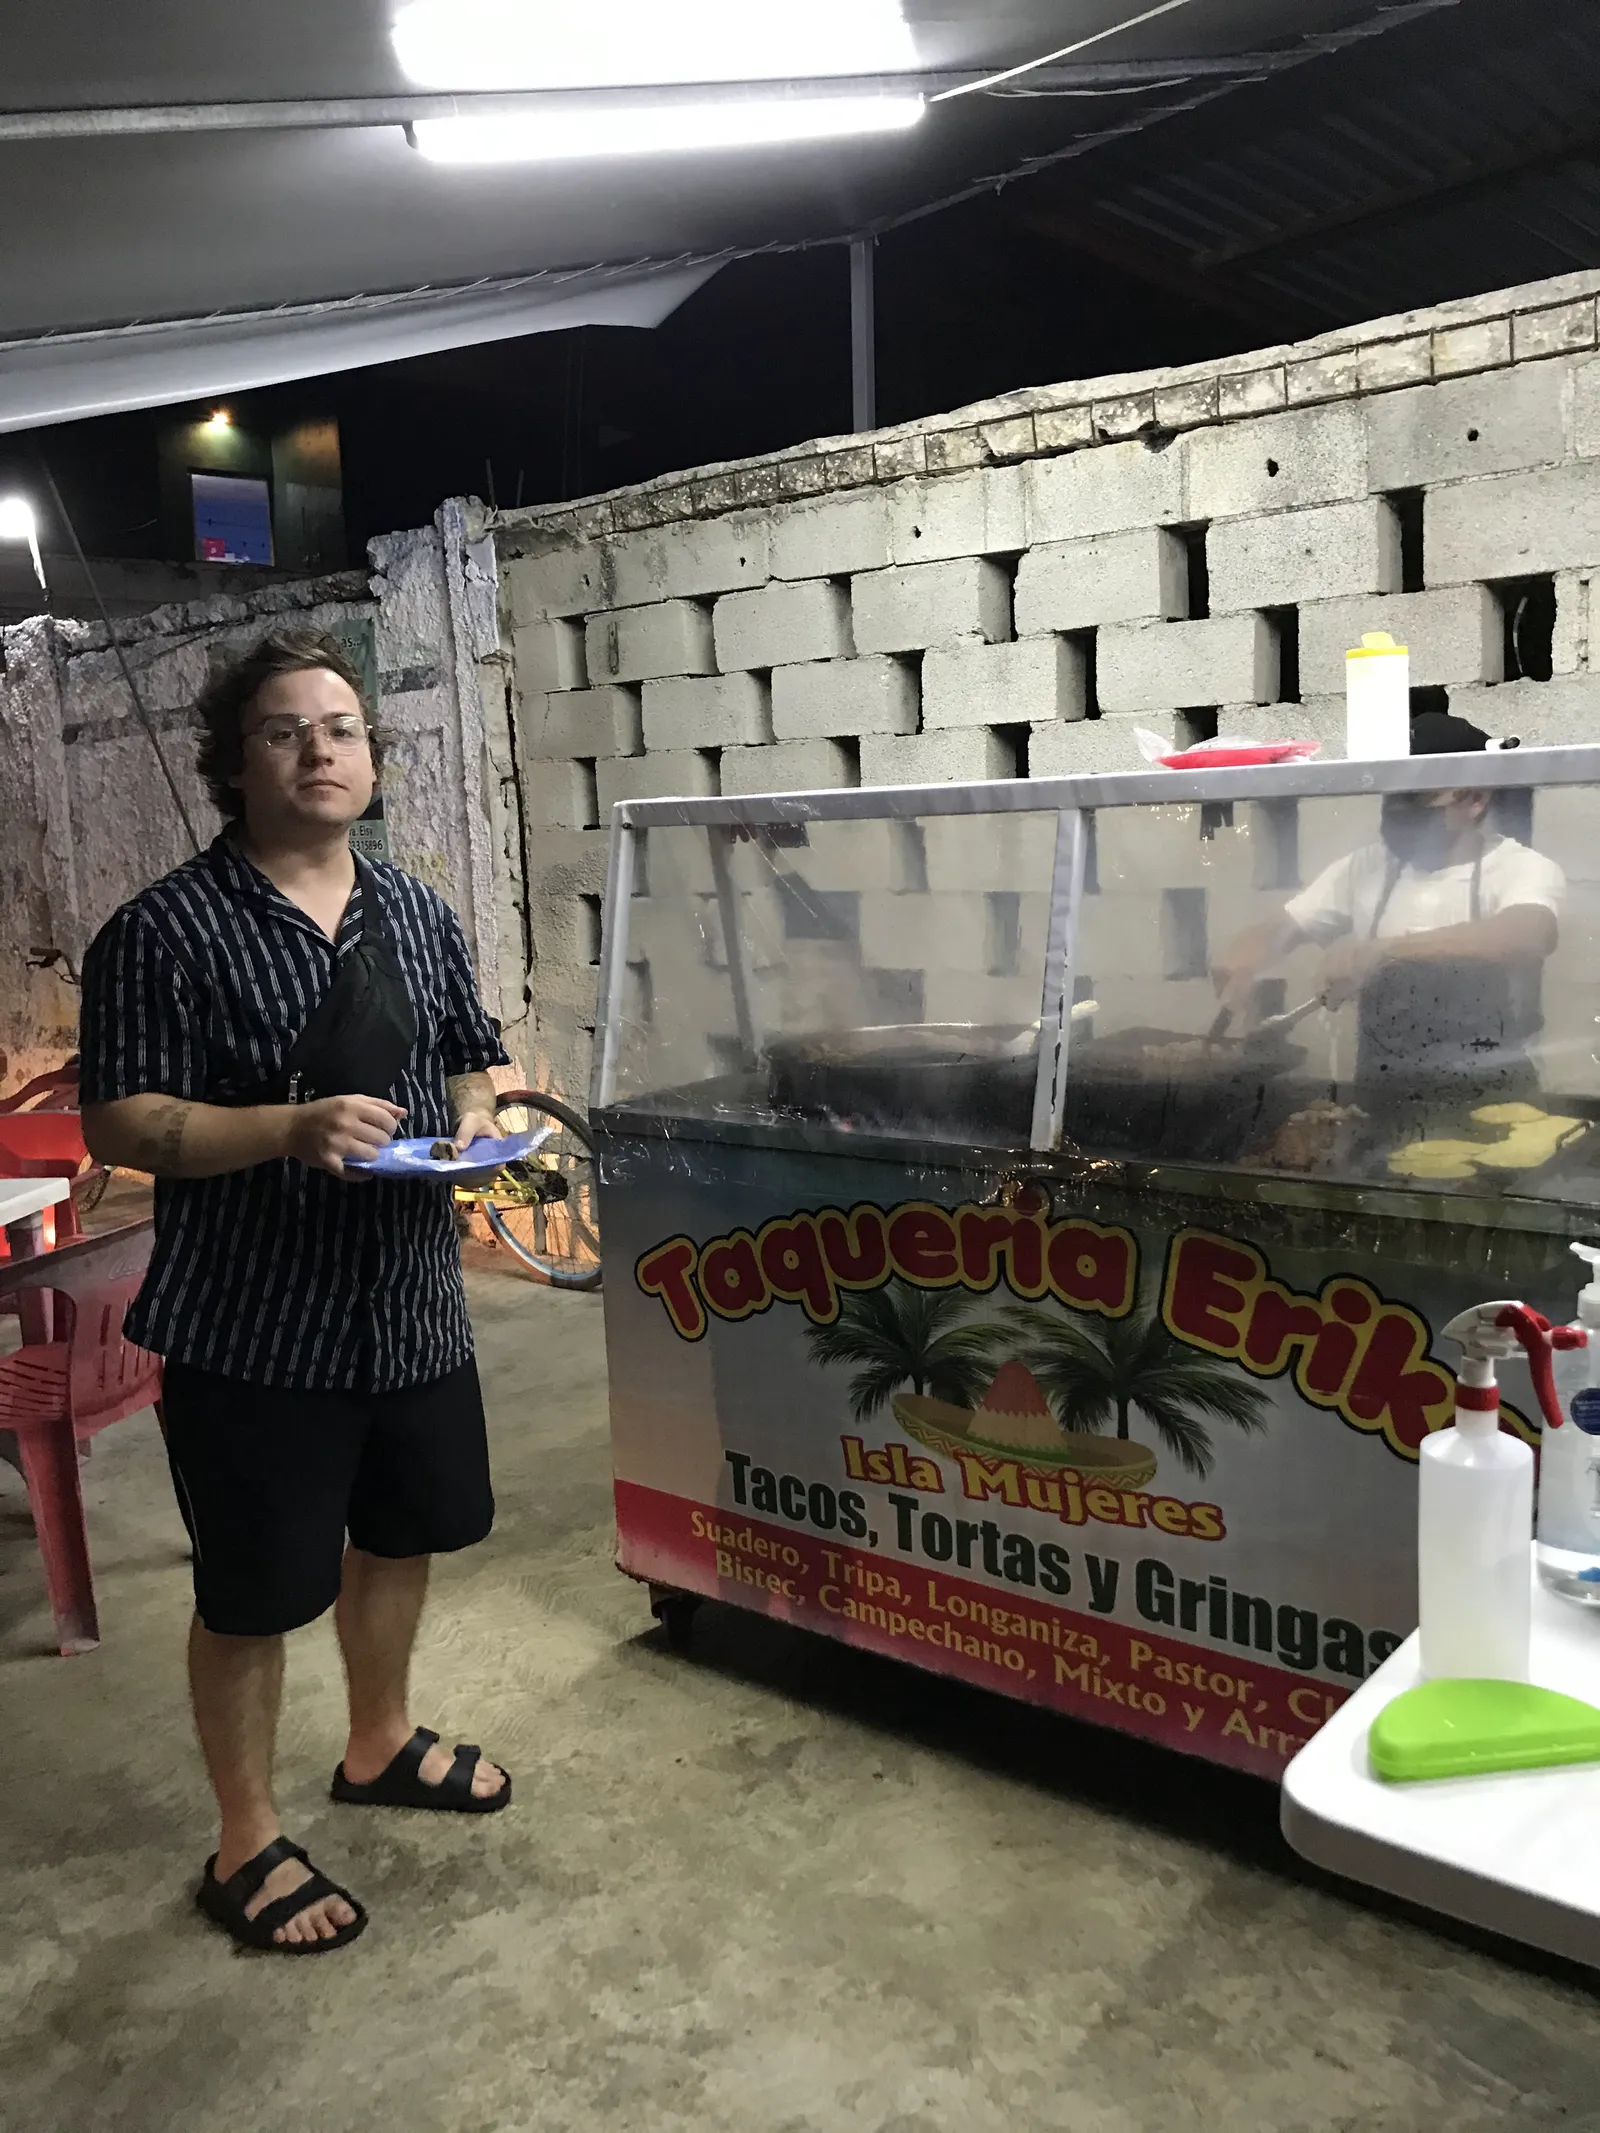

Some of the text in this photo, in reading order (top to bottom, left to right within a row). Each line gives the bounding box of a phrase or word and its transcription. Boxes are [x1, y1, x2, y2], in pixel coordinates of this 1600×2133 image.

[348, 840, 383, 851] 3315896
[360, 825, 373, 838] Elsy
[635, 1178, 1542, 1487] Taqueria Erik
[725, 1450, 879, 1548] Tacos,
[888, 1493, 1071, 1595] Tortas
[1085, 1553, 1120, 1614] y
[840, 1435, 1227, 1541] Isla Mujeres
[690, 1510, 809, 1575] Suadero,
[821, 1550, 912, 1606] Tripa,
[928, 1580, 1111, 1667] Longaniza,
[1130, 1639, 1268, 1713] Pastor,
[716, 1549, 1306, 1755] Bistec, Campechano, Mixto y Arr
